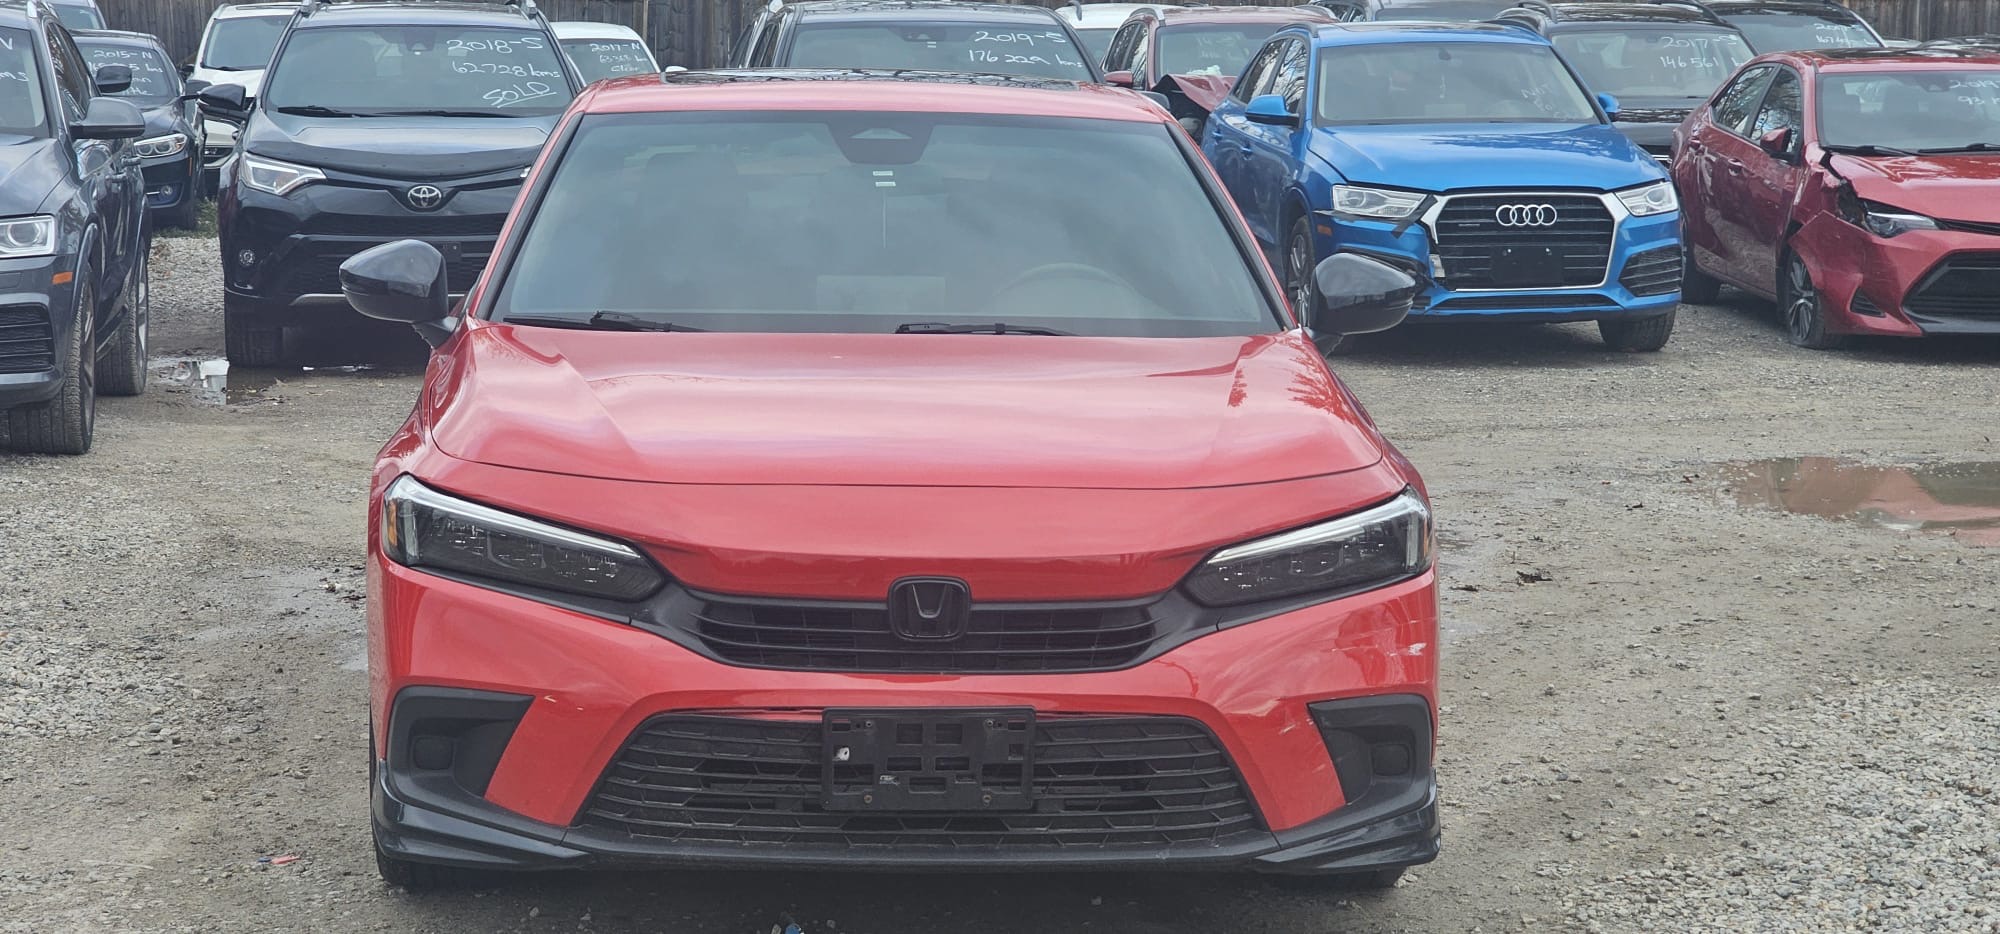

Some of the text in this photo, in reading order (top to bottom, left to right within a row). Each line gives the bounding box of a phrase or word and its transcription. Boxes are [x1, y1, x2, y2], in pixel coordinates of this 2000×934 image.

[446, 37, 543, 54] 2018-S
[974, 31, 1066, 46] 2019-S
[968, 49, 999, 62] 176
[451, 61, 527, 77] 62728
[482, 81, 551, 107] SOLD
